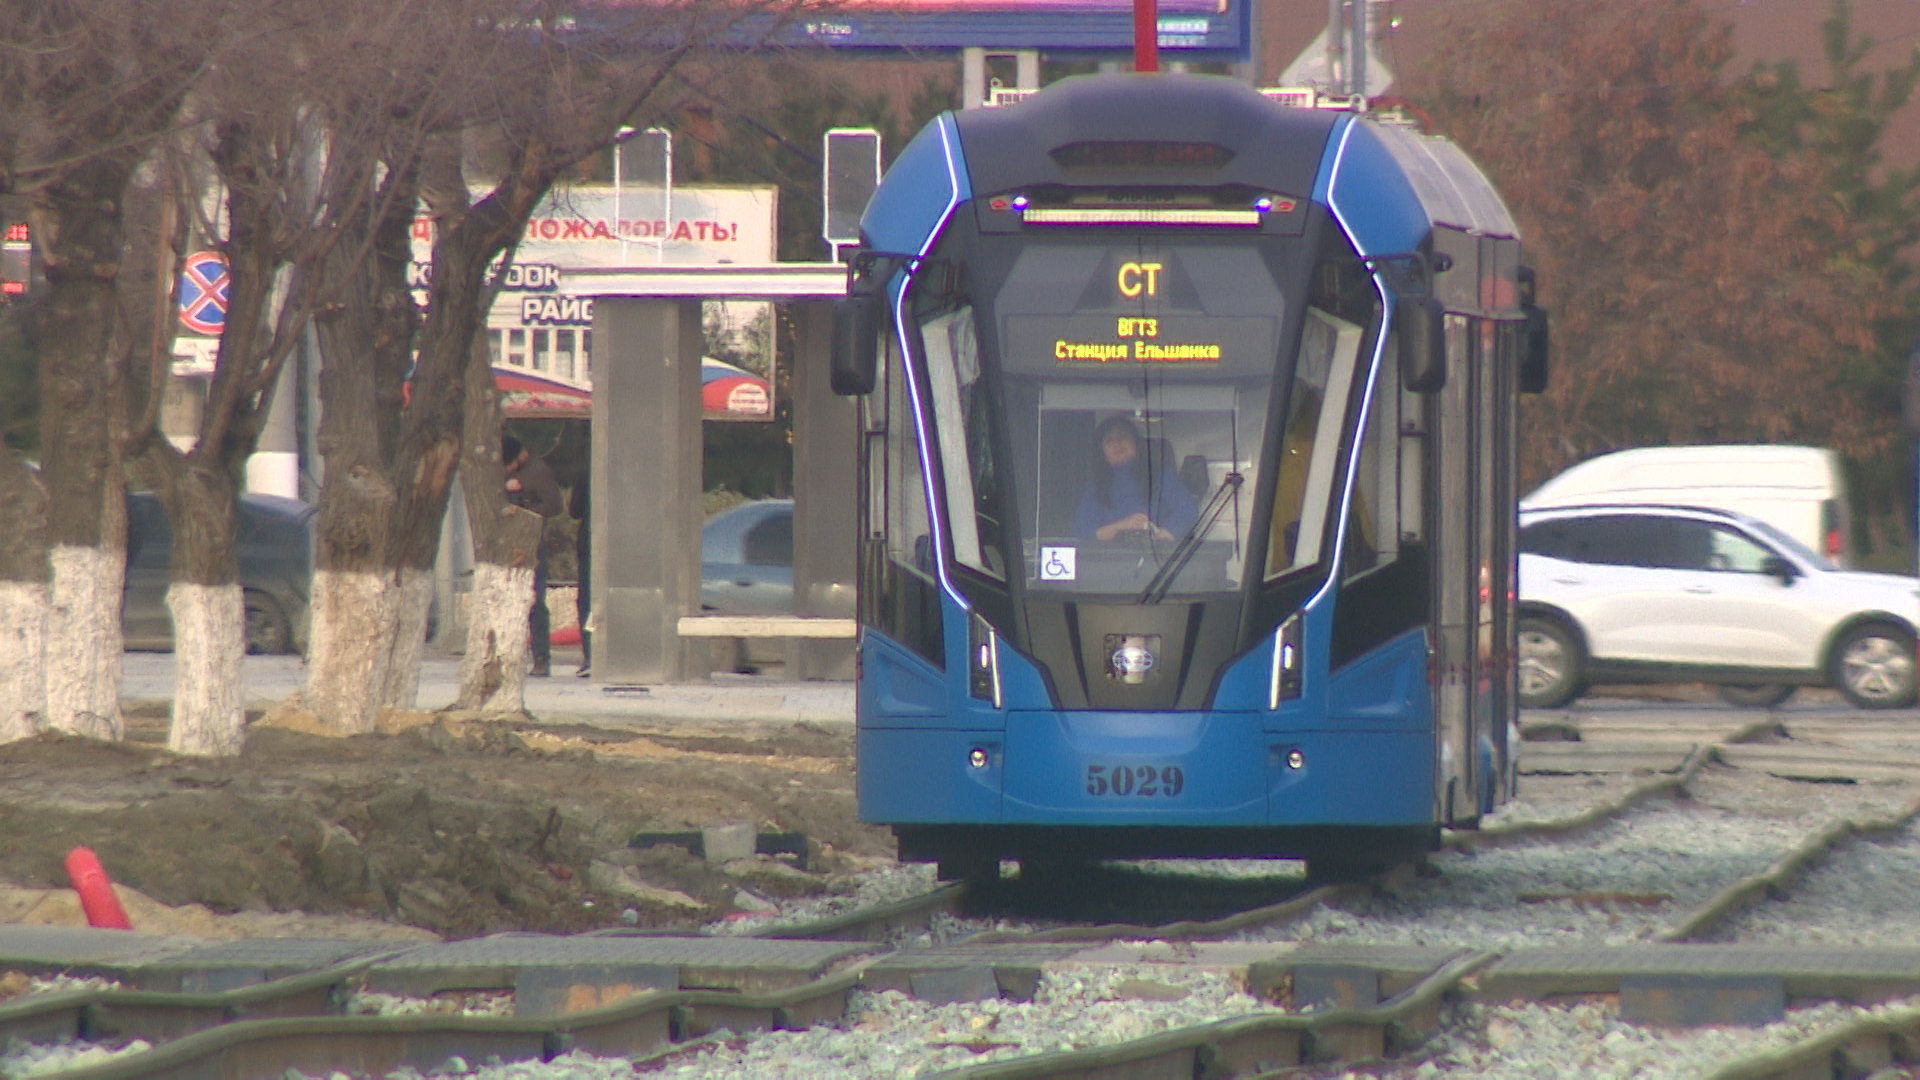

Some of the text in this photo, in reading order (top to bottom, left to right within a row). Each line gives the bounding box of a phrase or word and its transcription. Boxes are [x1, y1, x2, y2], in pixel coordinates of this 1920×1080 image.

[1117, 261, 1163, 297] СТ
[523, 296, 593, 321] РАЙО
[1055, 340, 1220, 362] Станция Ельшанка
[1086, 765, 1184, 797] 5029
